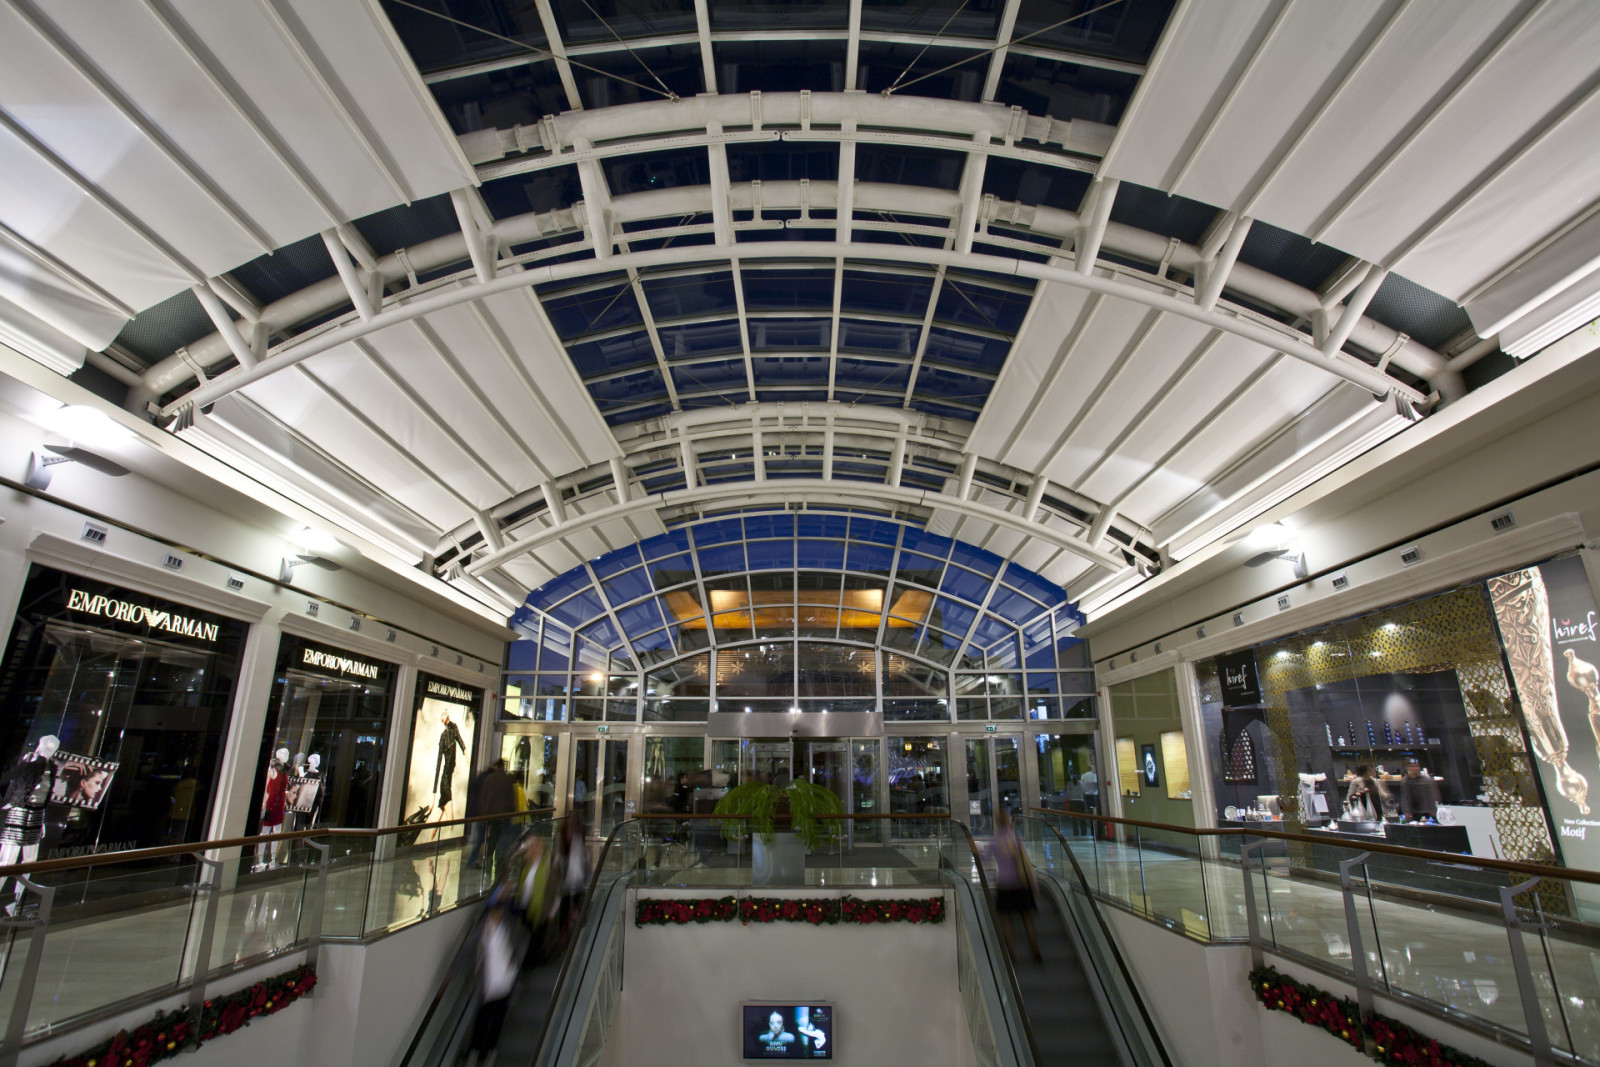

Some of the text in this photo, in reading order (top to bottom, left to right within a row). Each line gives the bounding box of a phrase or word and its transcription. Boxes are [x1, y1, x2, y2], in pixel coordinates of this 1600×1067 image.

[66, 589, 220, 642] EMPORIO ARMANI
[303, 648, 378, 679] EMPORIO ARMANI
[1560, 825, 1586, 840] Motif
